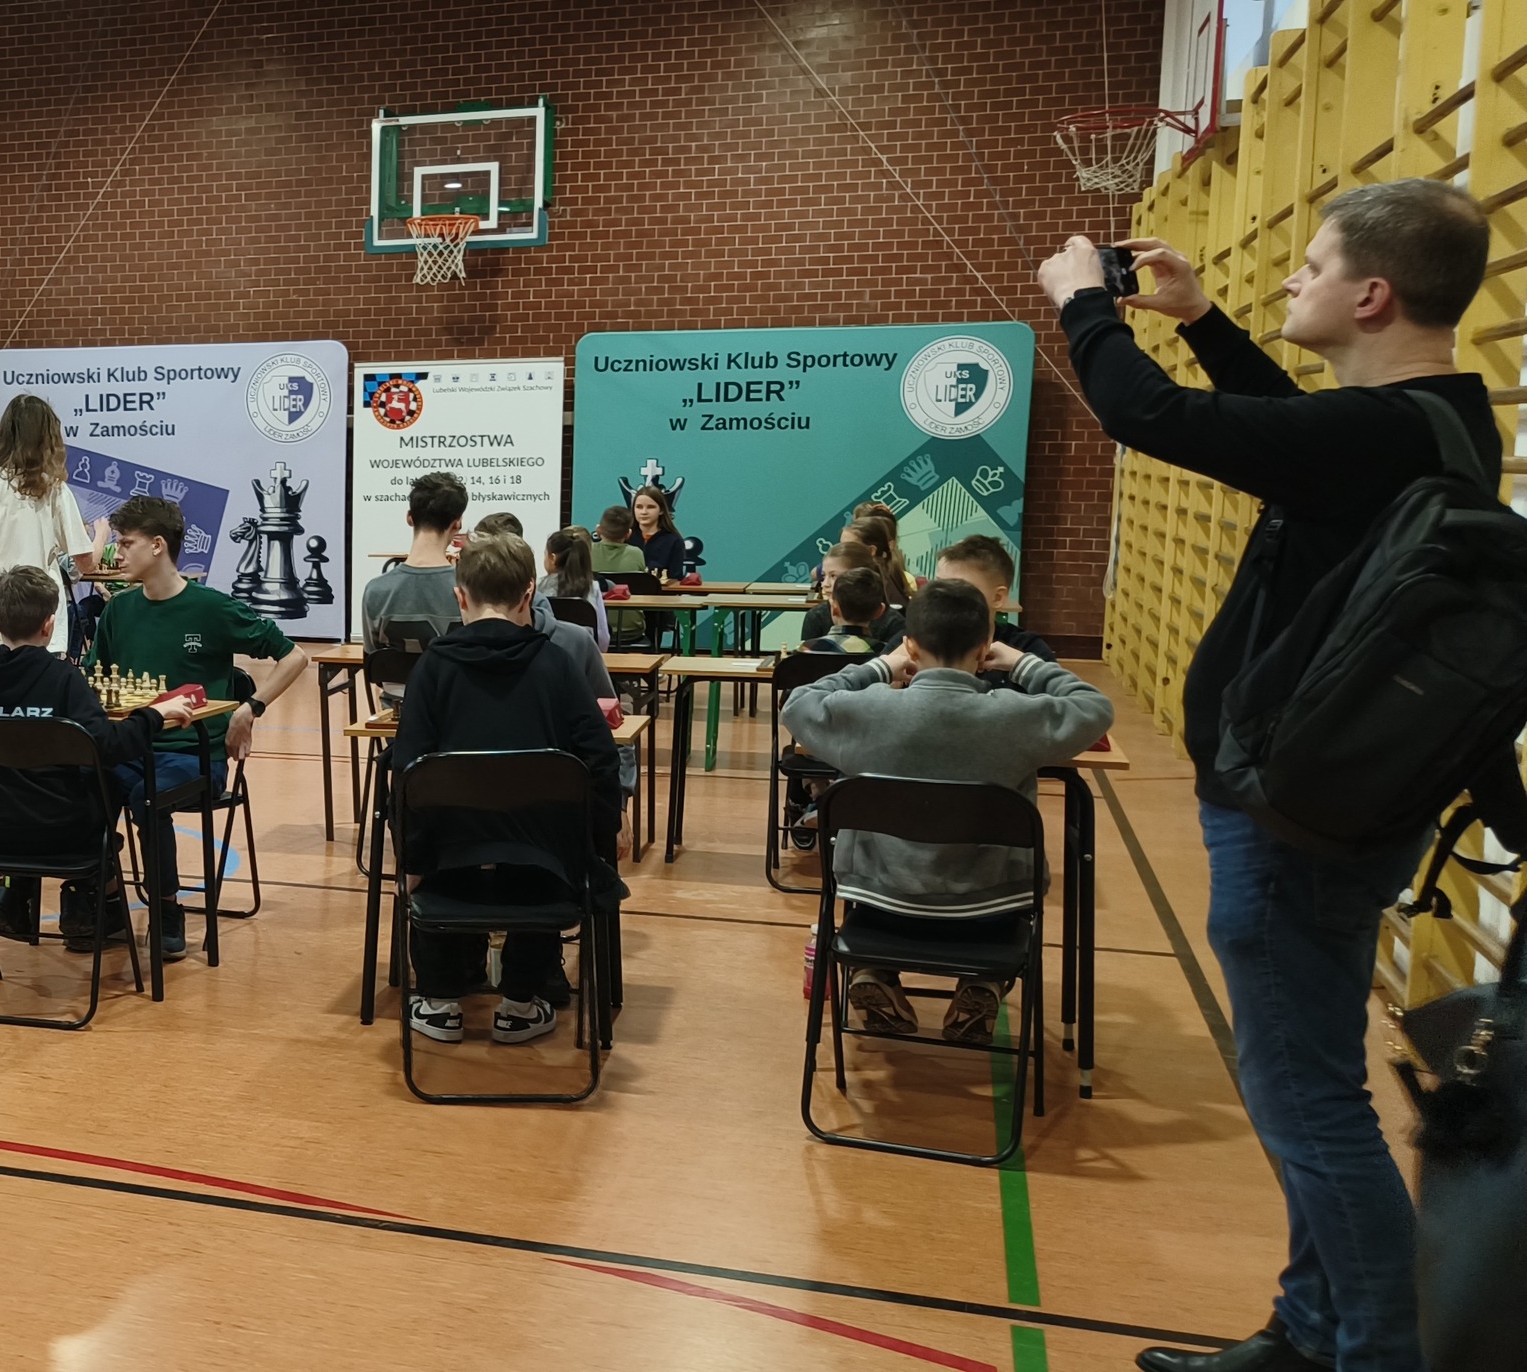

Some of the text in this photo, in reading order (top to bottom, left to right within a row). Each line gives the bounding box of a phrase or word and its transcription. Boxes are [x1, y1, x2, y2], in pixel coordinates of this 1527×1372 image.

[593, 350, 898, 373] Uczniowski Klub Sportowy
[948, 341, 975, 350] KLUB
[976, 345, 1007, 391] SPORTOWY
[2, 364, 241, 386] Uczniowski Klub Sportowy
[280, 356, 302, 365] KLUB
[302, 360, 328, 403] SPORTOWY
[945, 369, 970, 379] UKS
[278, 382, 299, 391] UKS
[681, 380, 801, 408] „LIDER”
[935, 383, 976, 403] LIDER
[73, 391, 166, 416] „LIDER”
[272, 395, 305, 412] LIDER
[64, 420, 176, 438] w Zamościu
[669, 412, 811, 432] w Zamościu
[399, 434, 515, 449] MISTRZOSTWA
[369, 456, 545, 469] WOJEWÓDZTWA LUBELSKIEGO
[390, 476, 403, 486] do
[470, 475, 485, 486] 14,
[489, 475, 501, 485] 16
[503, 475, 507, 485] i
[509, 475, 522, 485] 18
[363, 493, 373, 502] w
[471, 491, 550, 503] błyskawicznych
